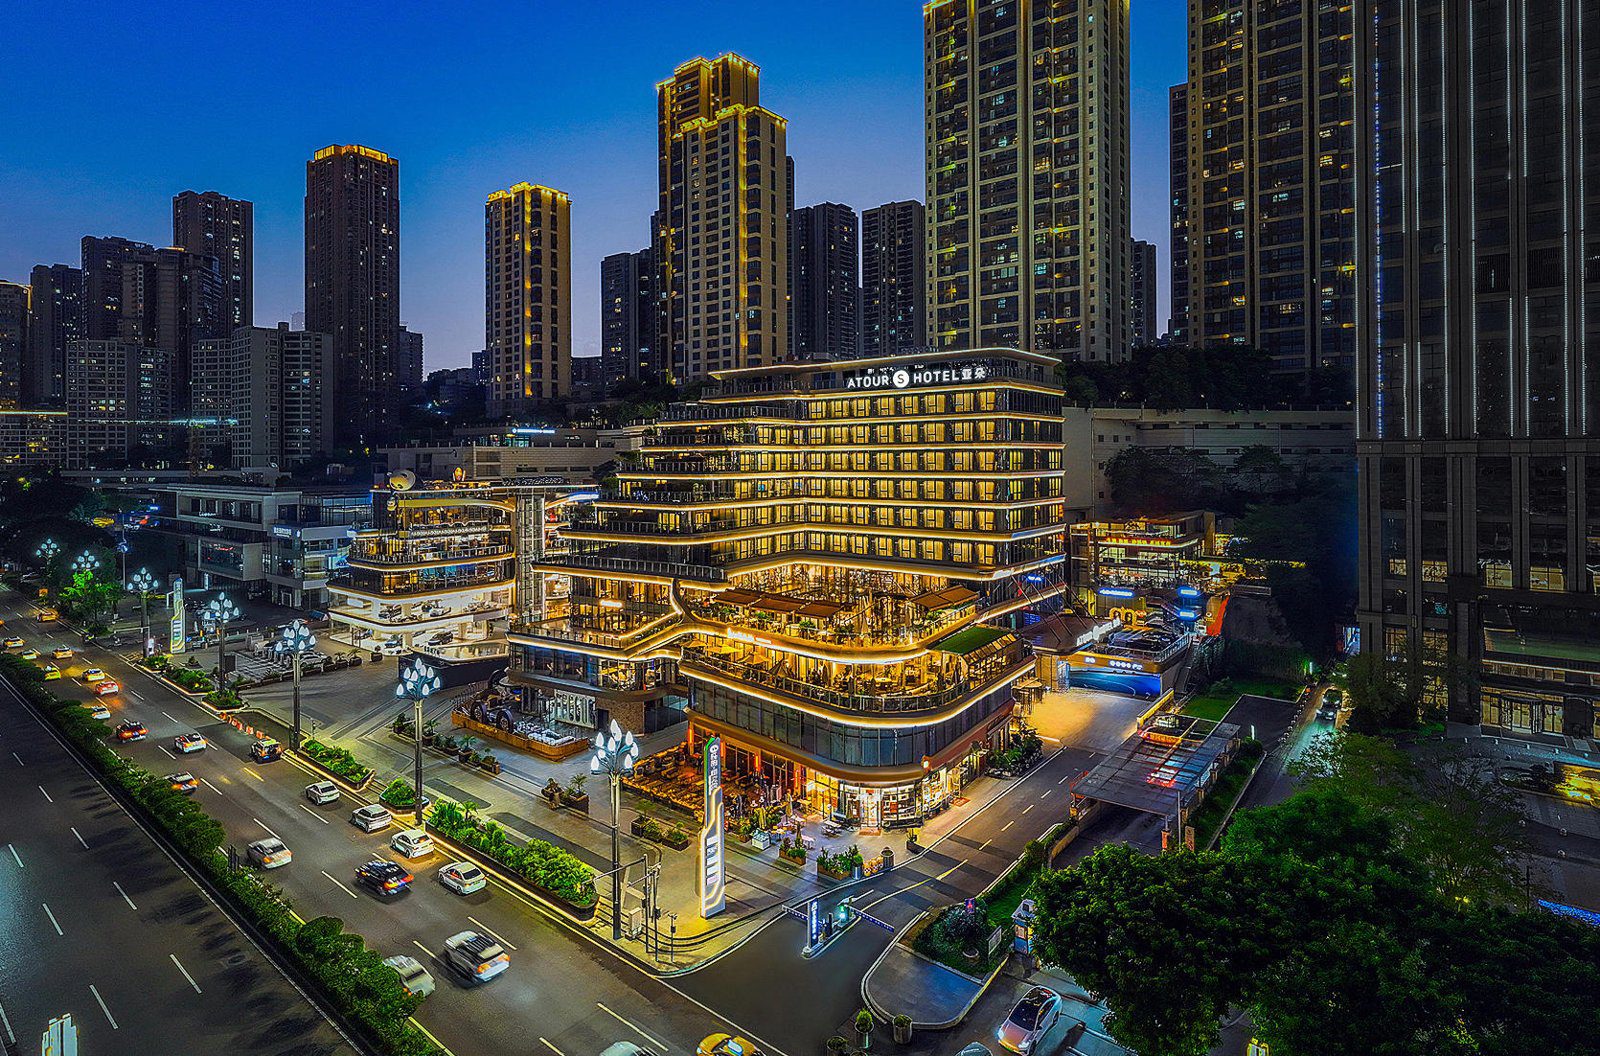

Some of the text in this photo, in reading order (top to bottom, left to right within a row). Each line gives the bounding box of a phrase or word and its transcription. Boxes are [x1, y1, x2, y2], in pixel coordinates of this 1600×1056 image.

[847, 375, 890, 388] ATOUR
[913, 370, 960, 384] HOTEL
[961, 367, 987, 380] 亚朵
